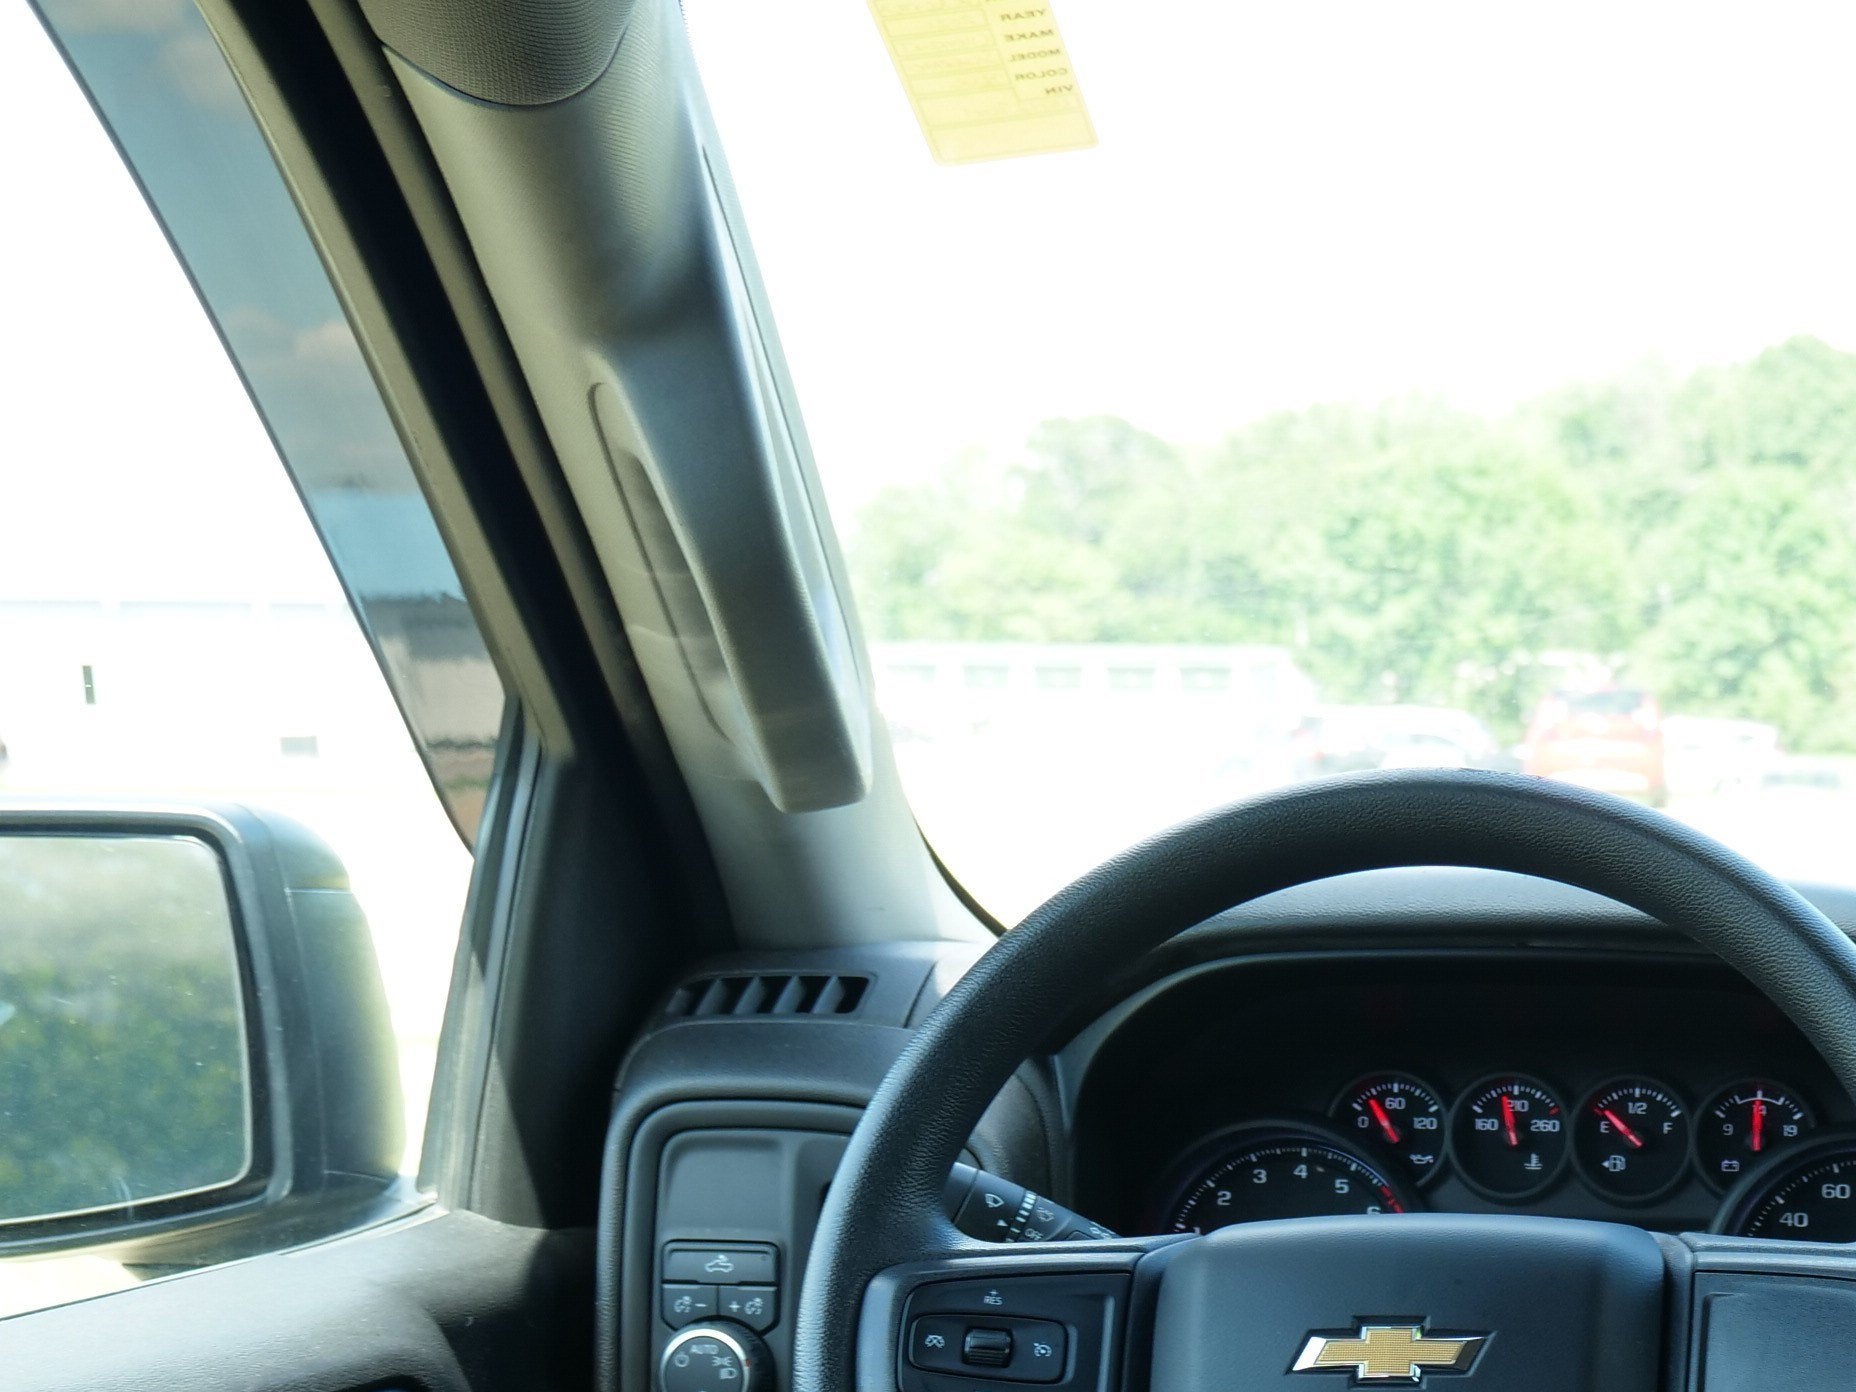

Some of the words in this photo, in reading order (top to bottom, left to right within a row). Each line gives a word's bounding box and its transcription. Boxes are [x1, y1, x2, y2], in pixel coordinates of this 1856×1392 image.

[1384, 1097, 1406, 1110] 60
[1627, 1102, 1648, 1115] 1/2
[1357, 1116, 1369, 1128] 0
[1413, 1117, 1438, 1130] 120
[1474, 1118, 1499, 1131] 160
[1530, 1120, 1560, 1132] 260
[1600, 1121, 1610, 1133] E
[1662, 1122, 1673, 1134] F
[1722, 1123, 1734, 1136] 9
[1782, 1125, 1798, 1137] 19
[1252, 1169, 1267, 1184] 3
[1292, 1165, 1308, 1179] 4
[1334, 1179, 1350, 1194] 5
[1821, 1184, 1850, 1199] 60
[1216, 1190, 1232, 1205] 2
[1778, 1212, 1809, 1227] 40
